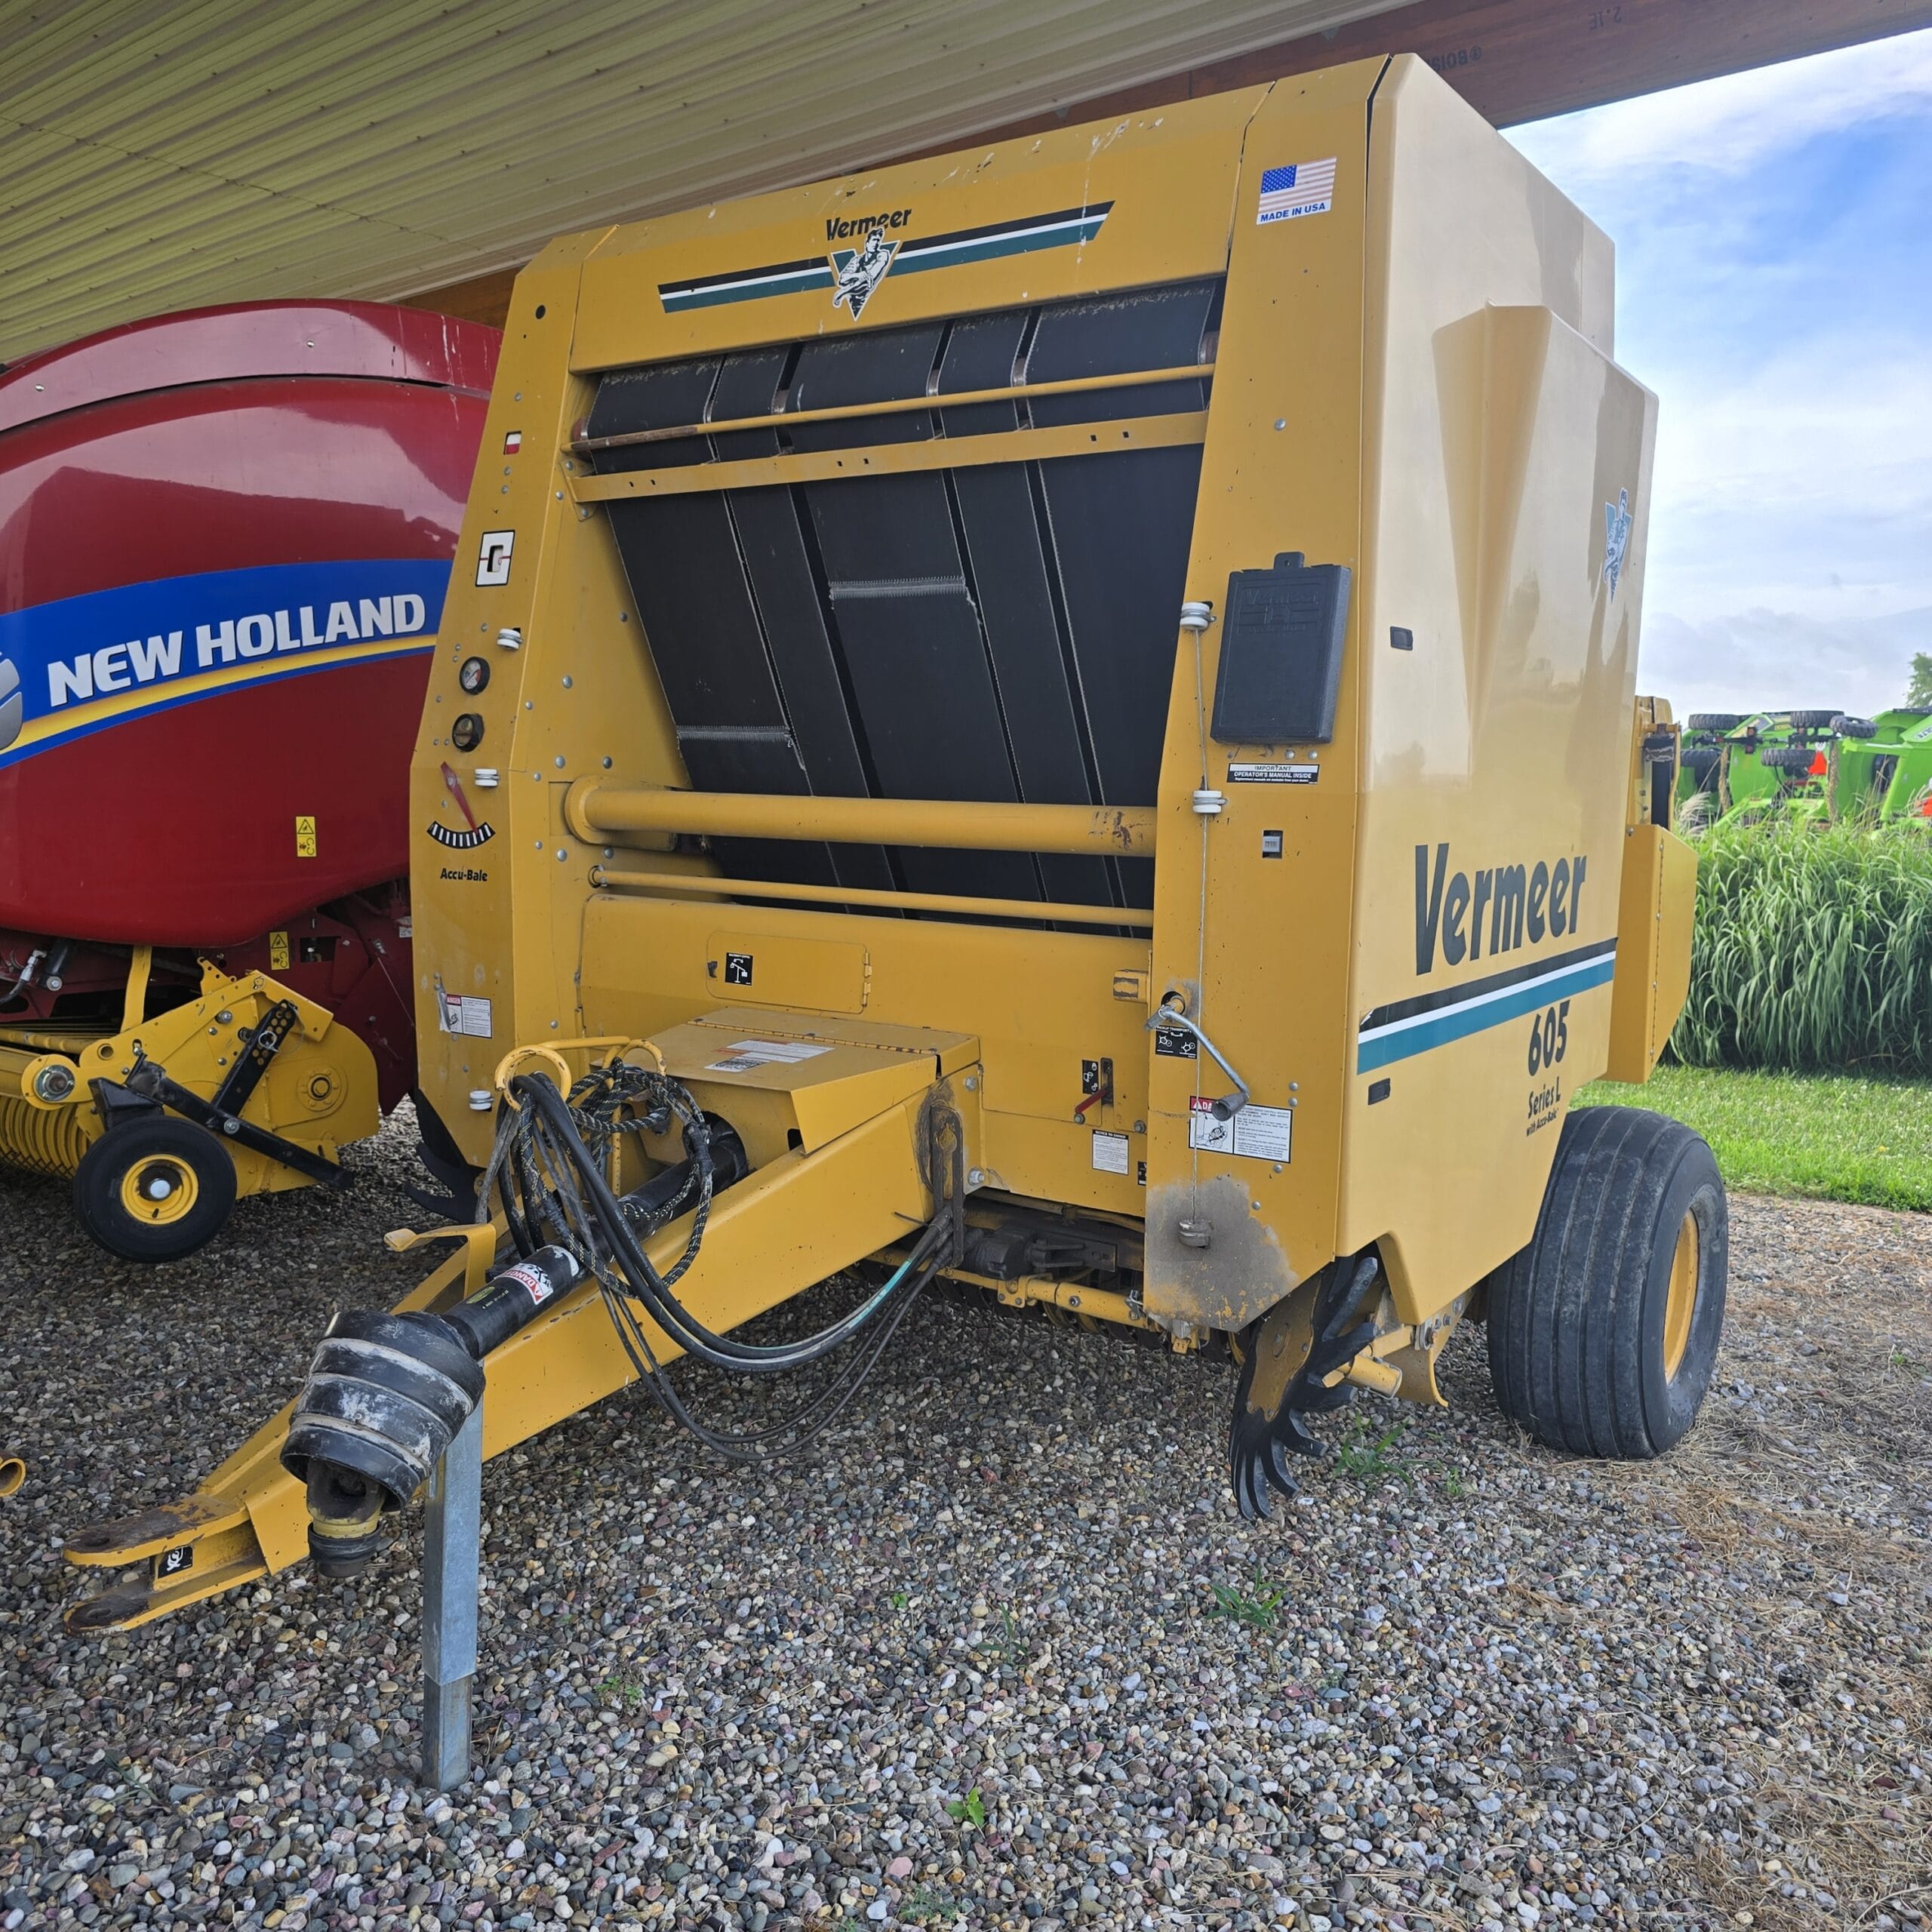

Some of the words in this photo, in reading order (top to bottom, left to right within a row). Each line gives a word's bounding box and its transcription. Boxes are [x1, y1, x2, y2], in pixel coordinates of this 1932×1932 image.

[826, 208, 912, 241] Vermeer
[1260, 210, 1289, 222] MADE
[1291, 207, 1302, 216] IN
[1304, 202, 1326, 213] USA
[48, 630, 183, 707] NEW
[195, 594, 426, 668] HOLLAND
[440, 868, 488, 881] Accu-Bale
[1415, 843, 1587, 976] Vermeer
[1528, 1000, 1571, 1076] 605
[1528, 1084, 1555, 1119] Series
[1556, 1076, 1561, 1103] L
